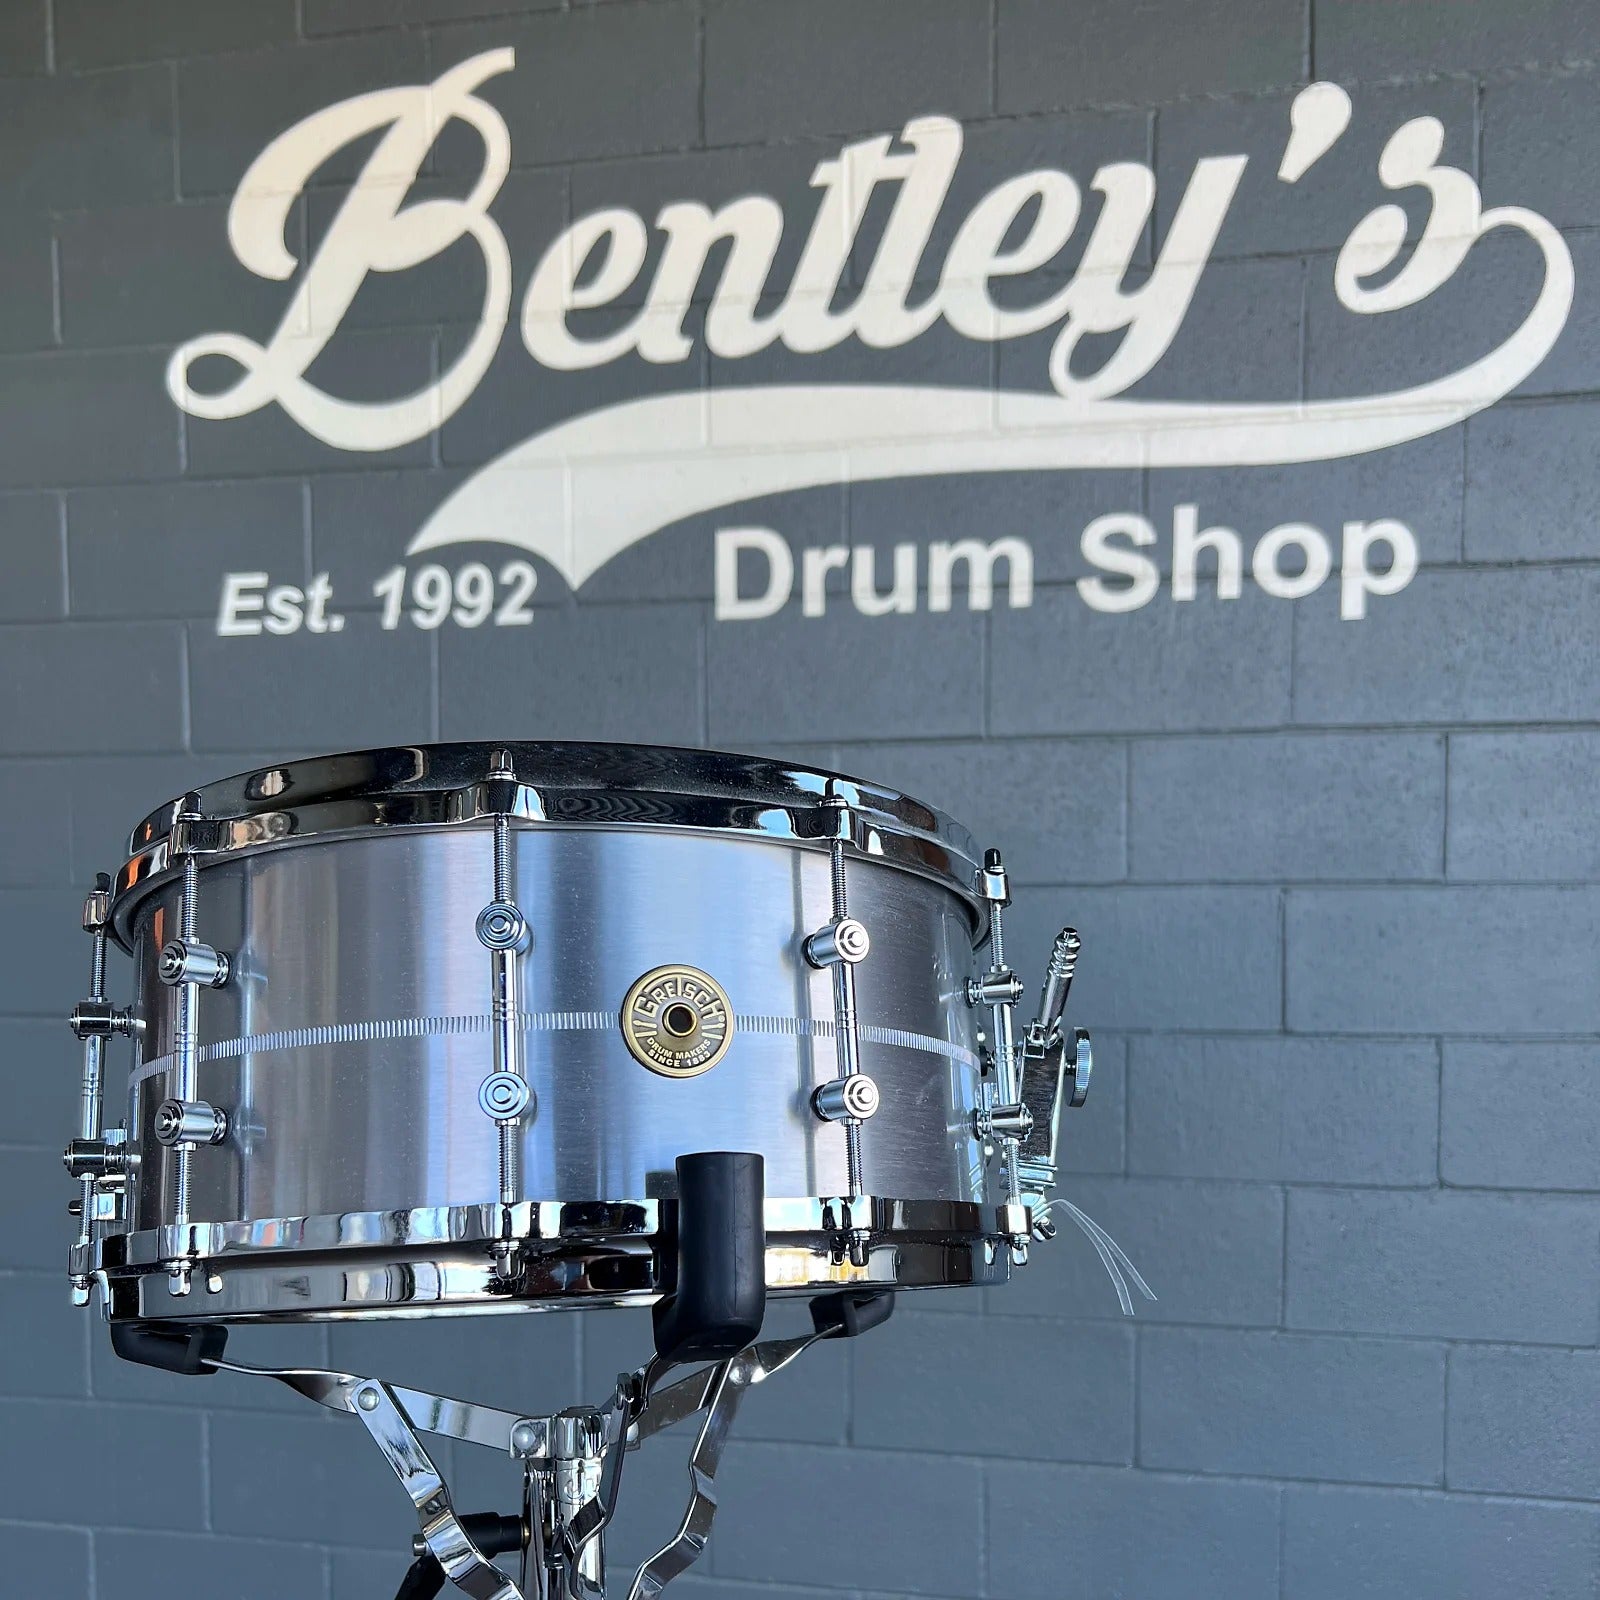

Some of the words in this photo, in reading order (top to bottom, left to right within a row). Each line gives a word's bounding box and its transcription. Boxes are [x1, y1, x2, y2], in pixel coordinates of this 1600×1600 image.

[166, 47, 1576, 451] Bentley's
[715, 527, 1034, 621] Drum
[1076, 503, 1420, 621] Shop
[217, 572, 345, 637] Est.
[374, 561, 538, 630] 1992
[633, 974, 725, 1019] GRETSCH
[647, 1037, 673, 1058] DRUM
[675, 1039, 711, 1060] MAKERS
[648, 1048, 680, 1067] SINCE
[686, 1051, 711, 1067] 1883
